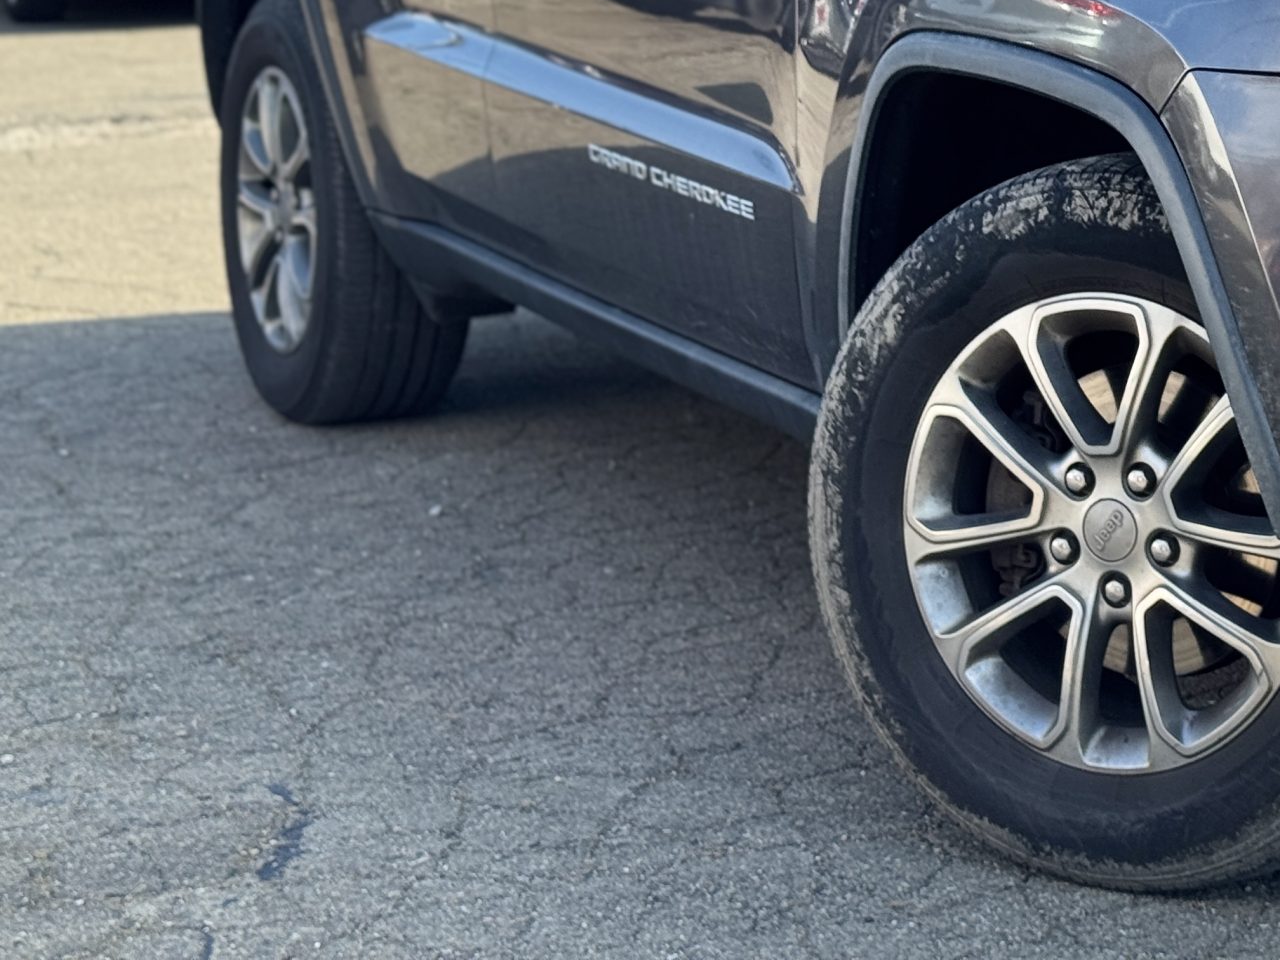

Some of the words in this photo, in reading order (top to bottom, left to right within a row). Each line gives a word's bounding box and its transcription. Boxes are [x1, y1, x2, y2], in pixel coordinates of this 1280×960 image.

[587, 143, 648, 180] GRAND
[649, 166, 756, 220] CHEROKEE
[1093, 509, 1124, 553] Jeep
